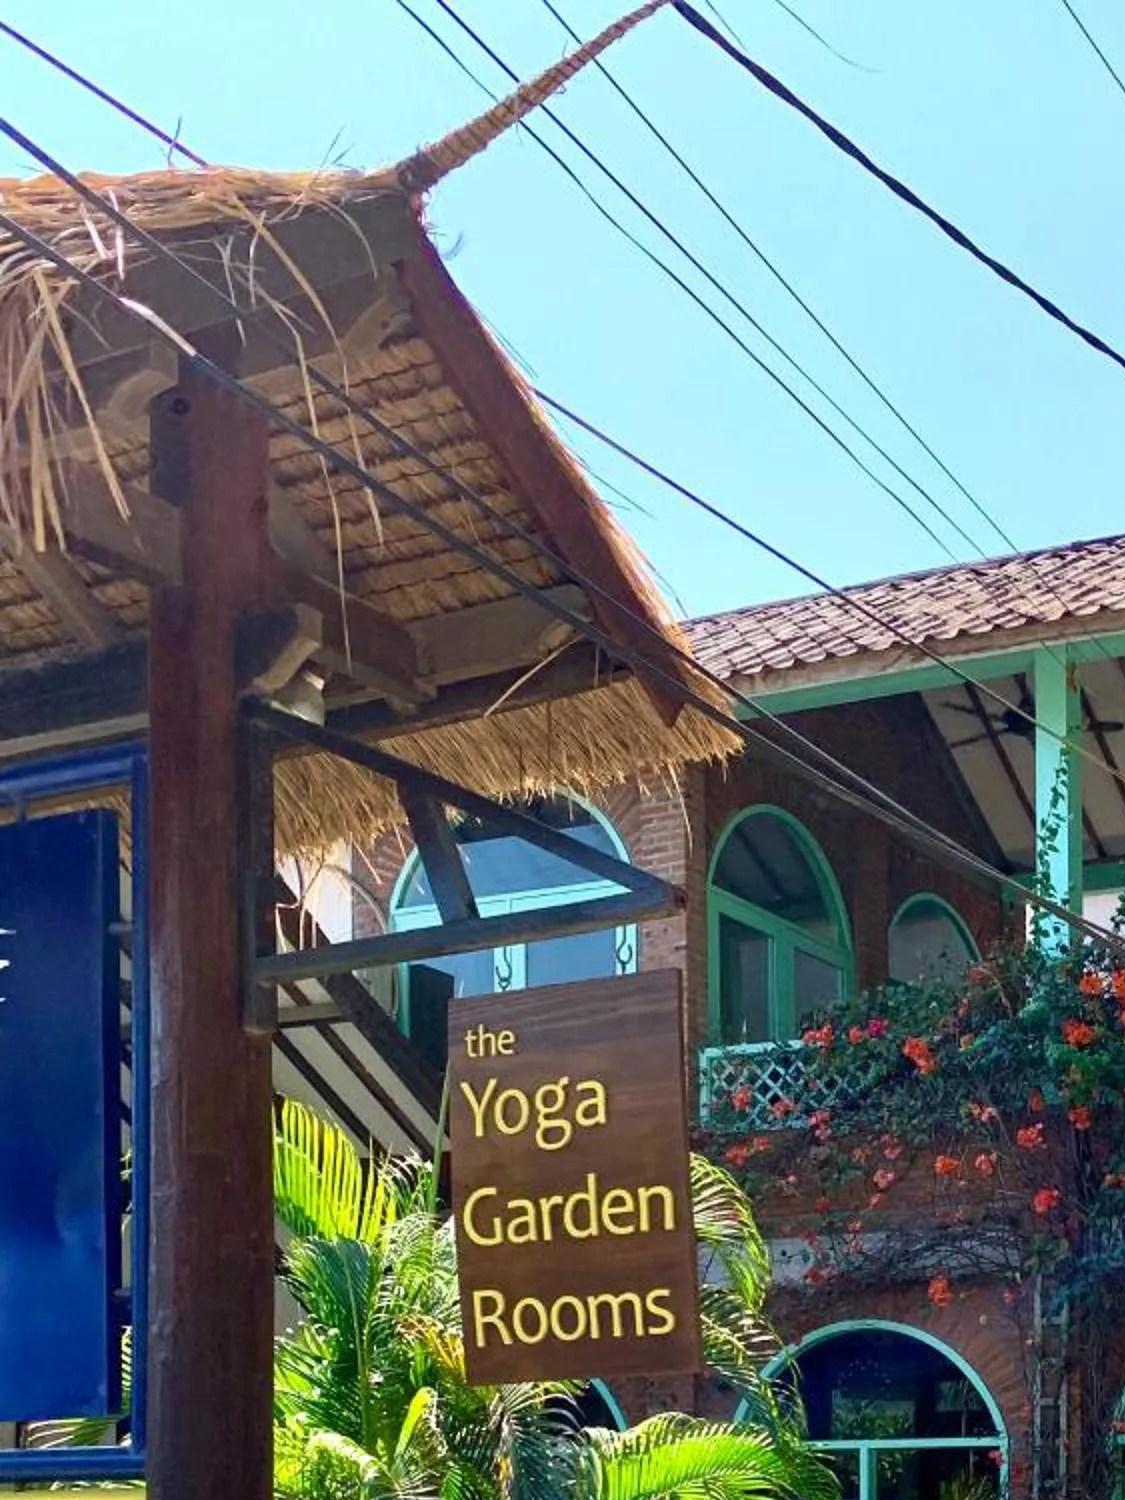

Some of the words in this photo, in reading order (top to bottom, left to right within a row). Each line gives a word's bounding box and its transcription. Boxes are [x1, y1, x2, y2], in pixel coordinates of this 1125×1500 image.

[465, 1024, 516, 1058] the
[460, 1075, 608, 1151] Yoga
[462, 1173, 676, 1247] Garden
[472, 1286, 676, 1348] Rooms
